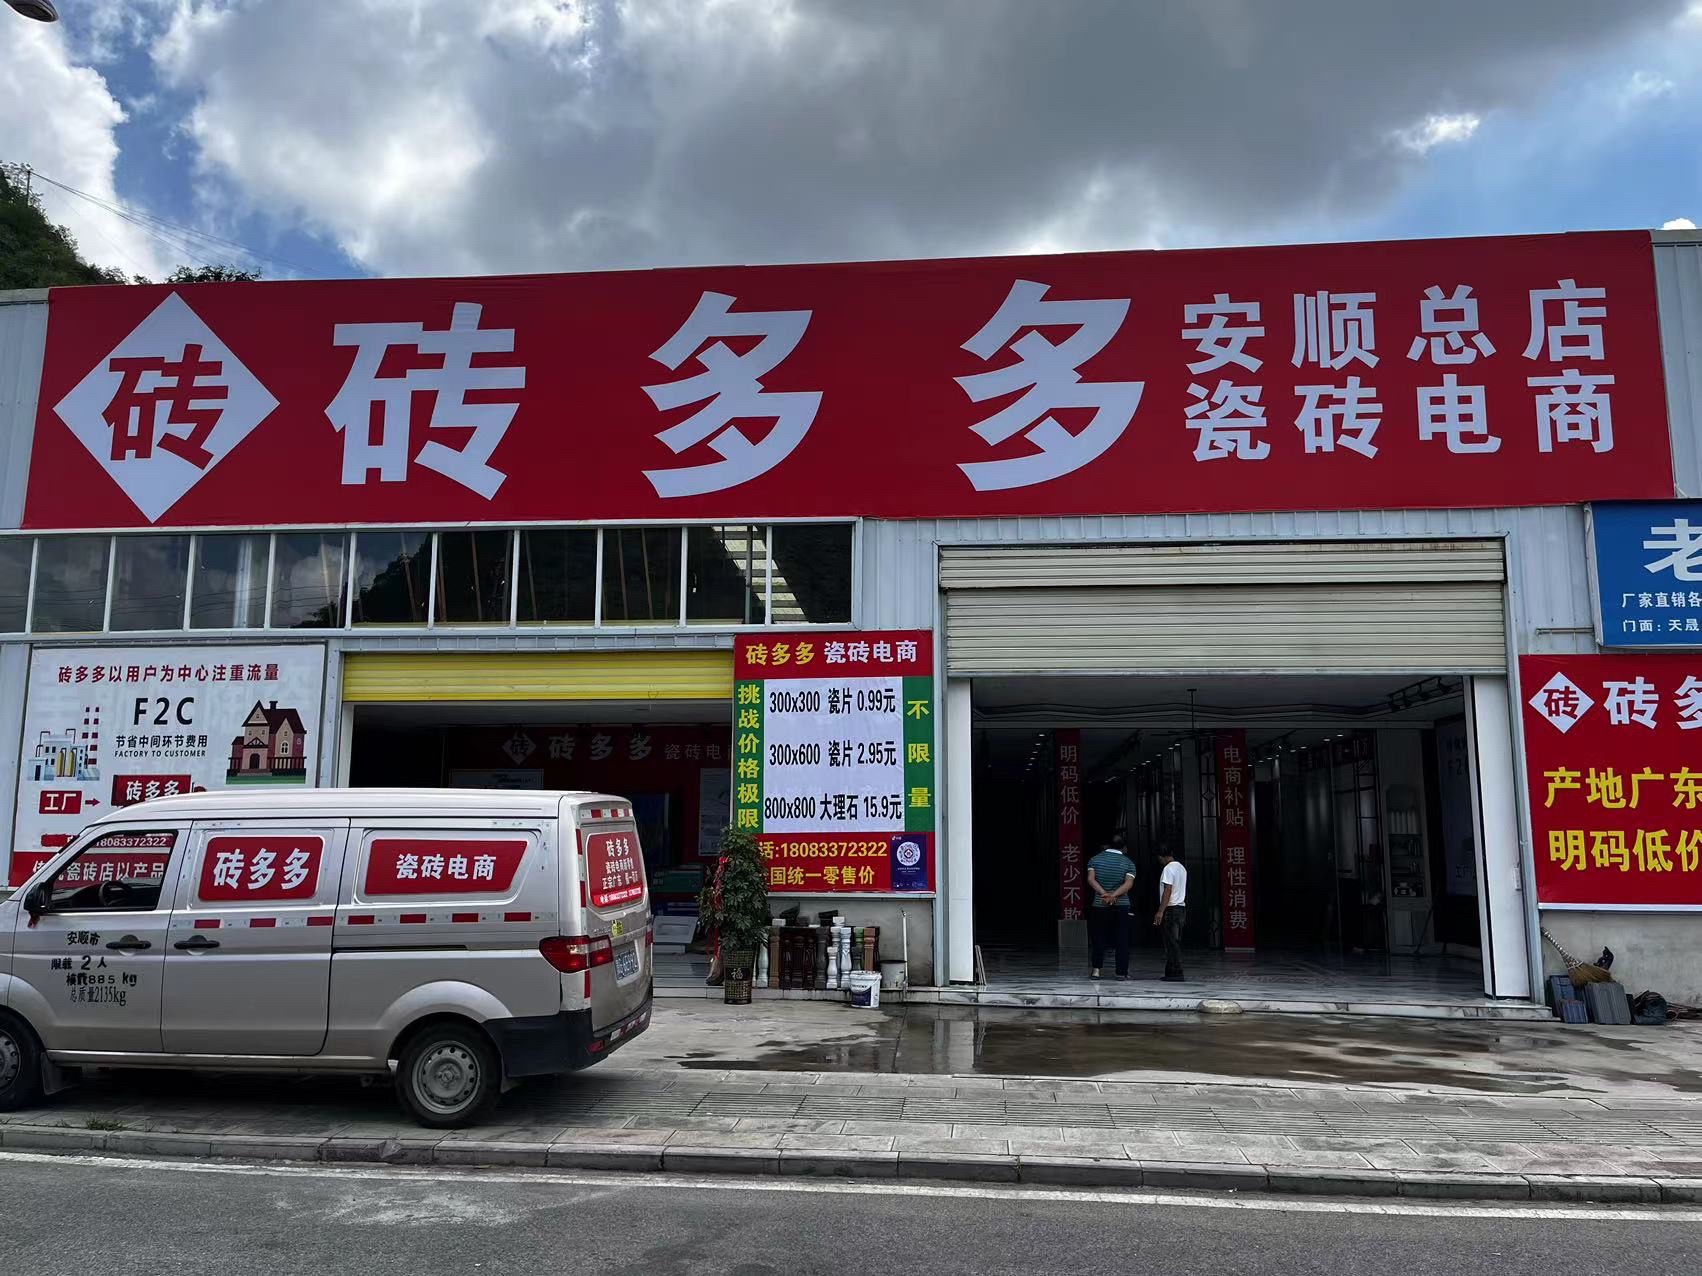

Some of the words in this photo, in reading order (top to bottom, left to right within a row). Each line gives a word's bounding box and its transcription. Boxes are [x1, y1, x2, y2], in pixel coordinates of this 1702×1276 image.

[1182, 278, 1607, 374] 安顺总店
[324, 279, 1145, 500] 砖多多
[101, 343, 229, 470] 砖
[1184, 368, 1615, 462] 瓷砖电商
[1644, 519, 1702, 581] 老
[1622, 592, 1702, 608] 厂家直销各
[745, 642, 815, 665] 砖多多
[824, 640, 918, 664] 瓷砖电商
[58, 664, 280, 683] 砖多多以用户为中心注重流量
[134, 697, 195, 726] F2C
[769, 691, 820, 713] 300x300
[828, 688, 852, 714] 瓷片
[857, 688, 896, 713] 0.99元
[1543, 685, 1580, 720] 砖
[116, 734, 208, 748] 节省中间环节费用
[549, 735, 652, 761] 砖多多
[664, 744, 732, 760] 瓷砖电
[769, 743, 820, 766] 300x600
[828, 740, 853, 767] 瓷片
[857, 741, 896, 766] 2.95元
[907, 700, 931, 808] 不限量
[737, 684, 760, 829] 挑战价格极限
[126, 780, 179, 801] 砖多多
[1060, 746, 1080, 825] 明码低价
[1223, 746, 1244, 828] 电商补贴
[1544, 766, 1702, 809] 产地广东
[44, 793, 76, 810] 工厂
[765, 796, 816, 820] 800x800
[819, 794, 858, 821] 大理石
[863, 794, 902, 820] 15.9元
[759, 841, 888, 859] 话:18083372322
[1548, 829, 1702, 872] 明码低价
[213, 848, 311, 890] 砖多多
[396, 853, 496, 880] 瓷砖电商
[768, 866, 875, 886] 国统一零售价
[1226, 848, 1248, 930] 理性消费
[67, 931, 100, 946] 安顺市
[81, 955, 91, 970] 2
[97, 957, 107, 968] 人
